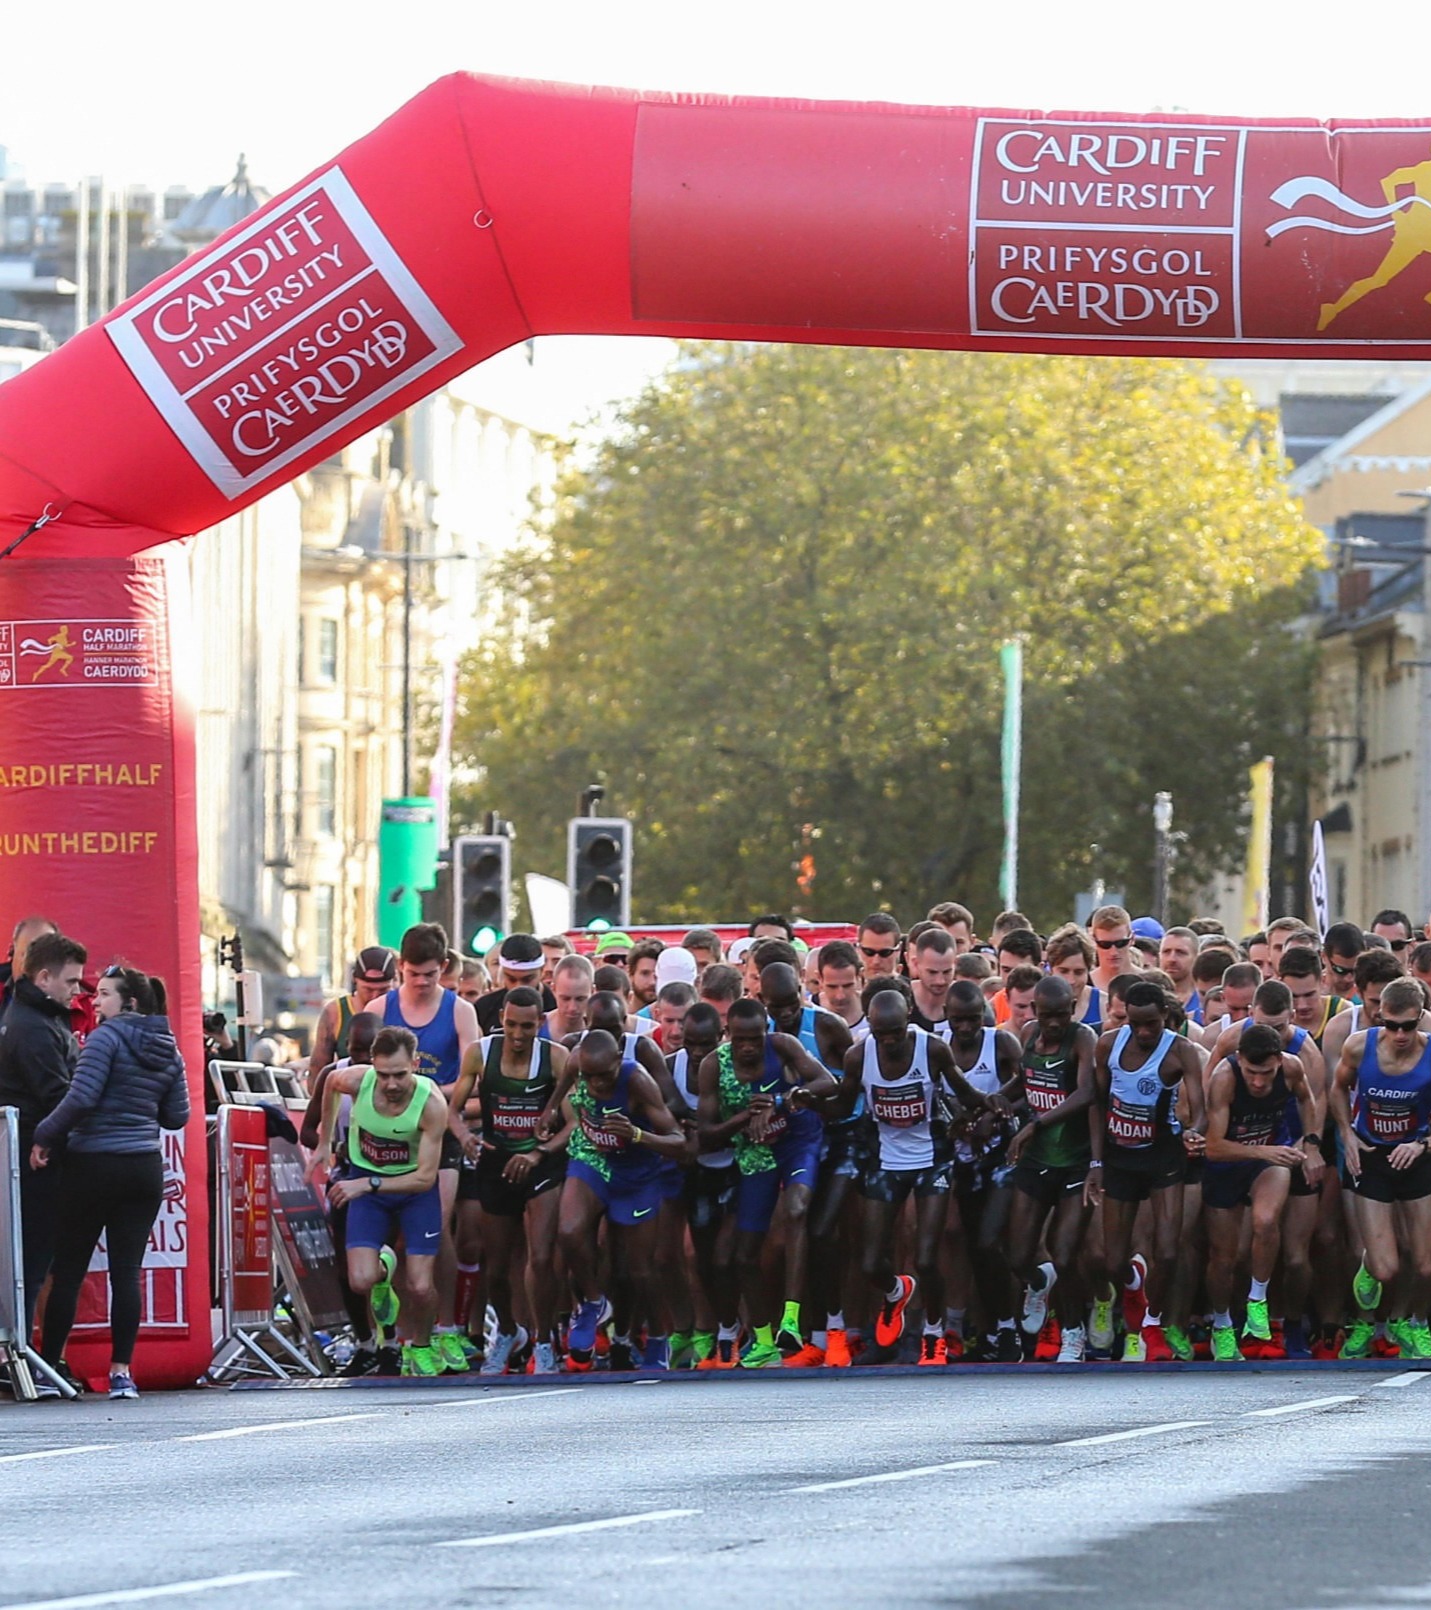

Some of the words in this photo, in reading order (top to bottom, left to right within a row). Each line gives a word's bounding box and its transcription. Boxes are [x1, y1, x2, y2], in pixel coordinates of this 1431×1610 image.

[996, 130, 1225, 176] CARDIFF
[1001, 179, 1215, 210] UNIVERSITY
[999, 244, 1212, 275] PRIFYSGOL
[152, 200, 327, 344] CARDIFF
[178, 244, 346, 369] UNIVERSITY
[212, 296, 383, 418] PRIFYSGOL
[83, 628, 147, 642] CARDIFF
[107, 643, 148, 651] MARATHON
[84, 665, 148, 677] CAERDYDD
[0, 764, 163, 787] ARDIFFHALF
[1368, 1087, 1419, 1099] CARDIFF
[874, 1101, 926, 1119] CHEBET
[493, 1114, 541, 1128] MEKONE
[1108, 1117, 1152, 1138] AADAN
[1374, 1118, 1411, 1134] HUNT
[362, 1143, 409, 1160] HULSON
